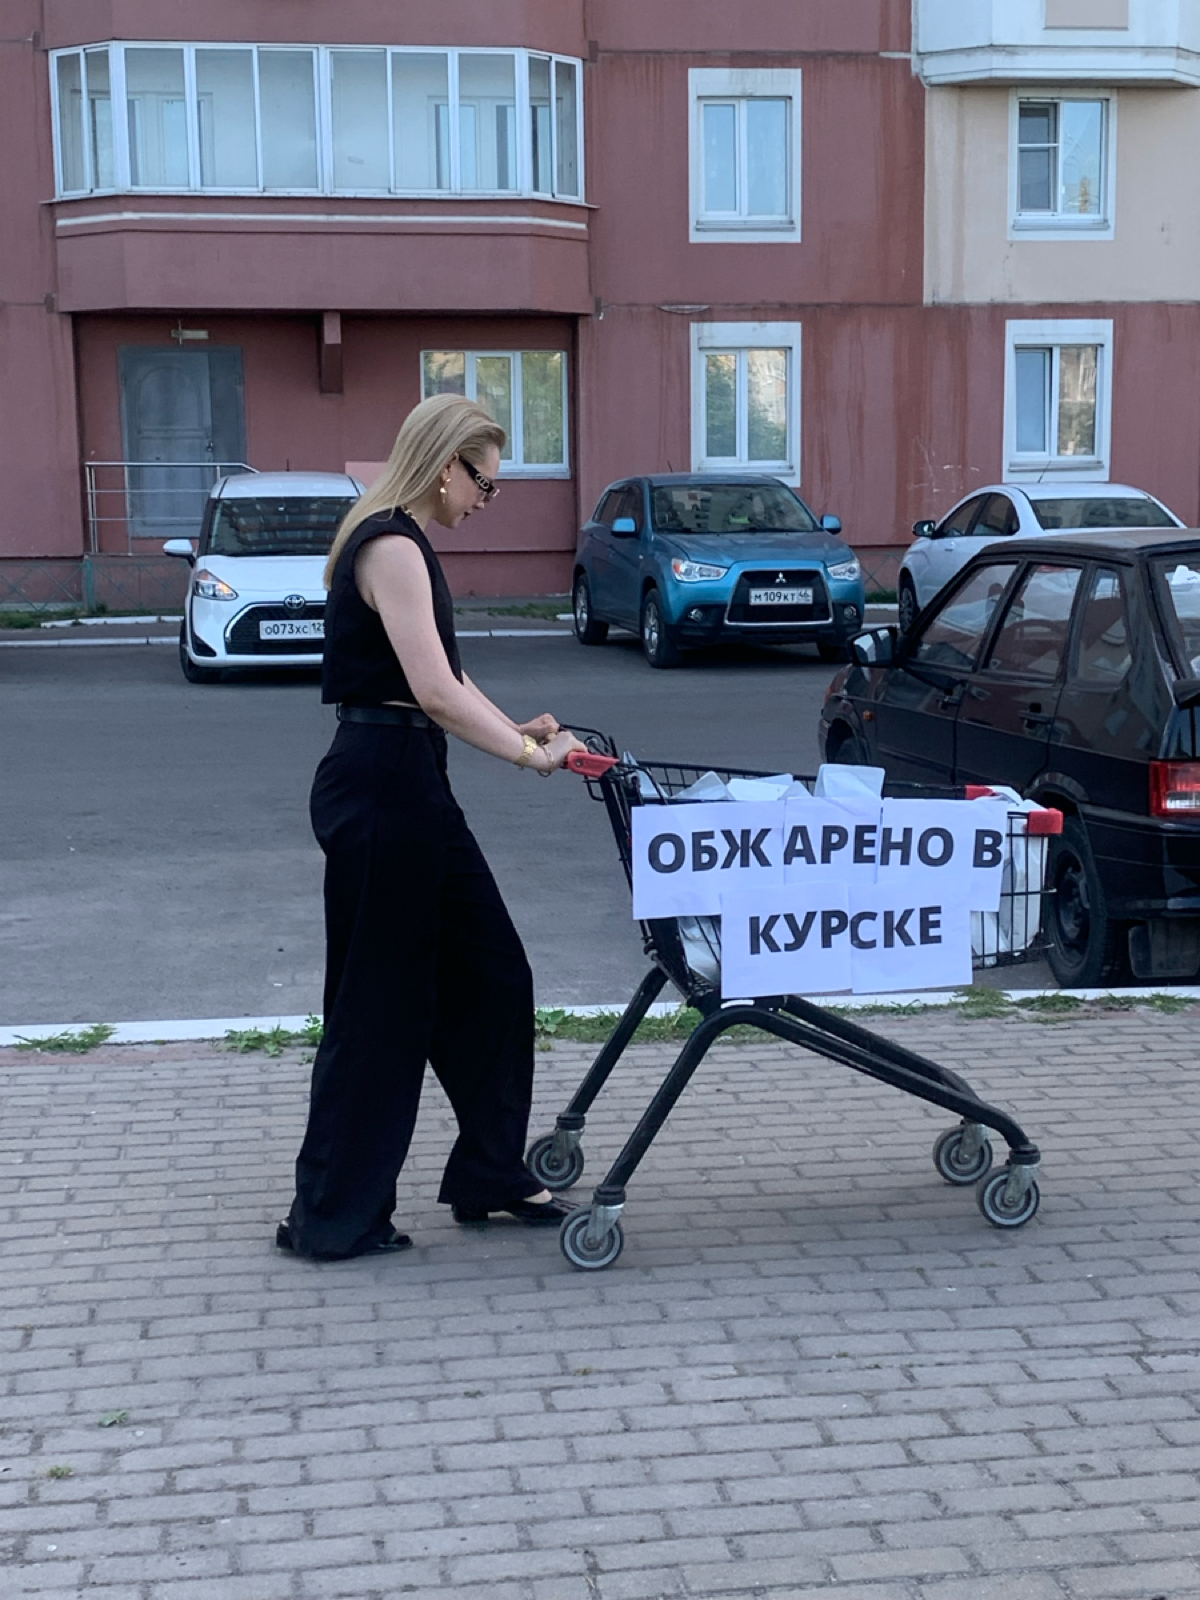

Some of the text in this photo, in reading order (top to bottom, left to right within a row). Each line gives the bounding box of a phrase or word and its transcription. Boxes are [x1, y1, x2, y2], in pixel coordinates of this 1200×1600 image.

[647, 824, 1003, 873] ОБЖАРЕНО В
[749, 906, 942, 955] КУРСКЕ
